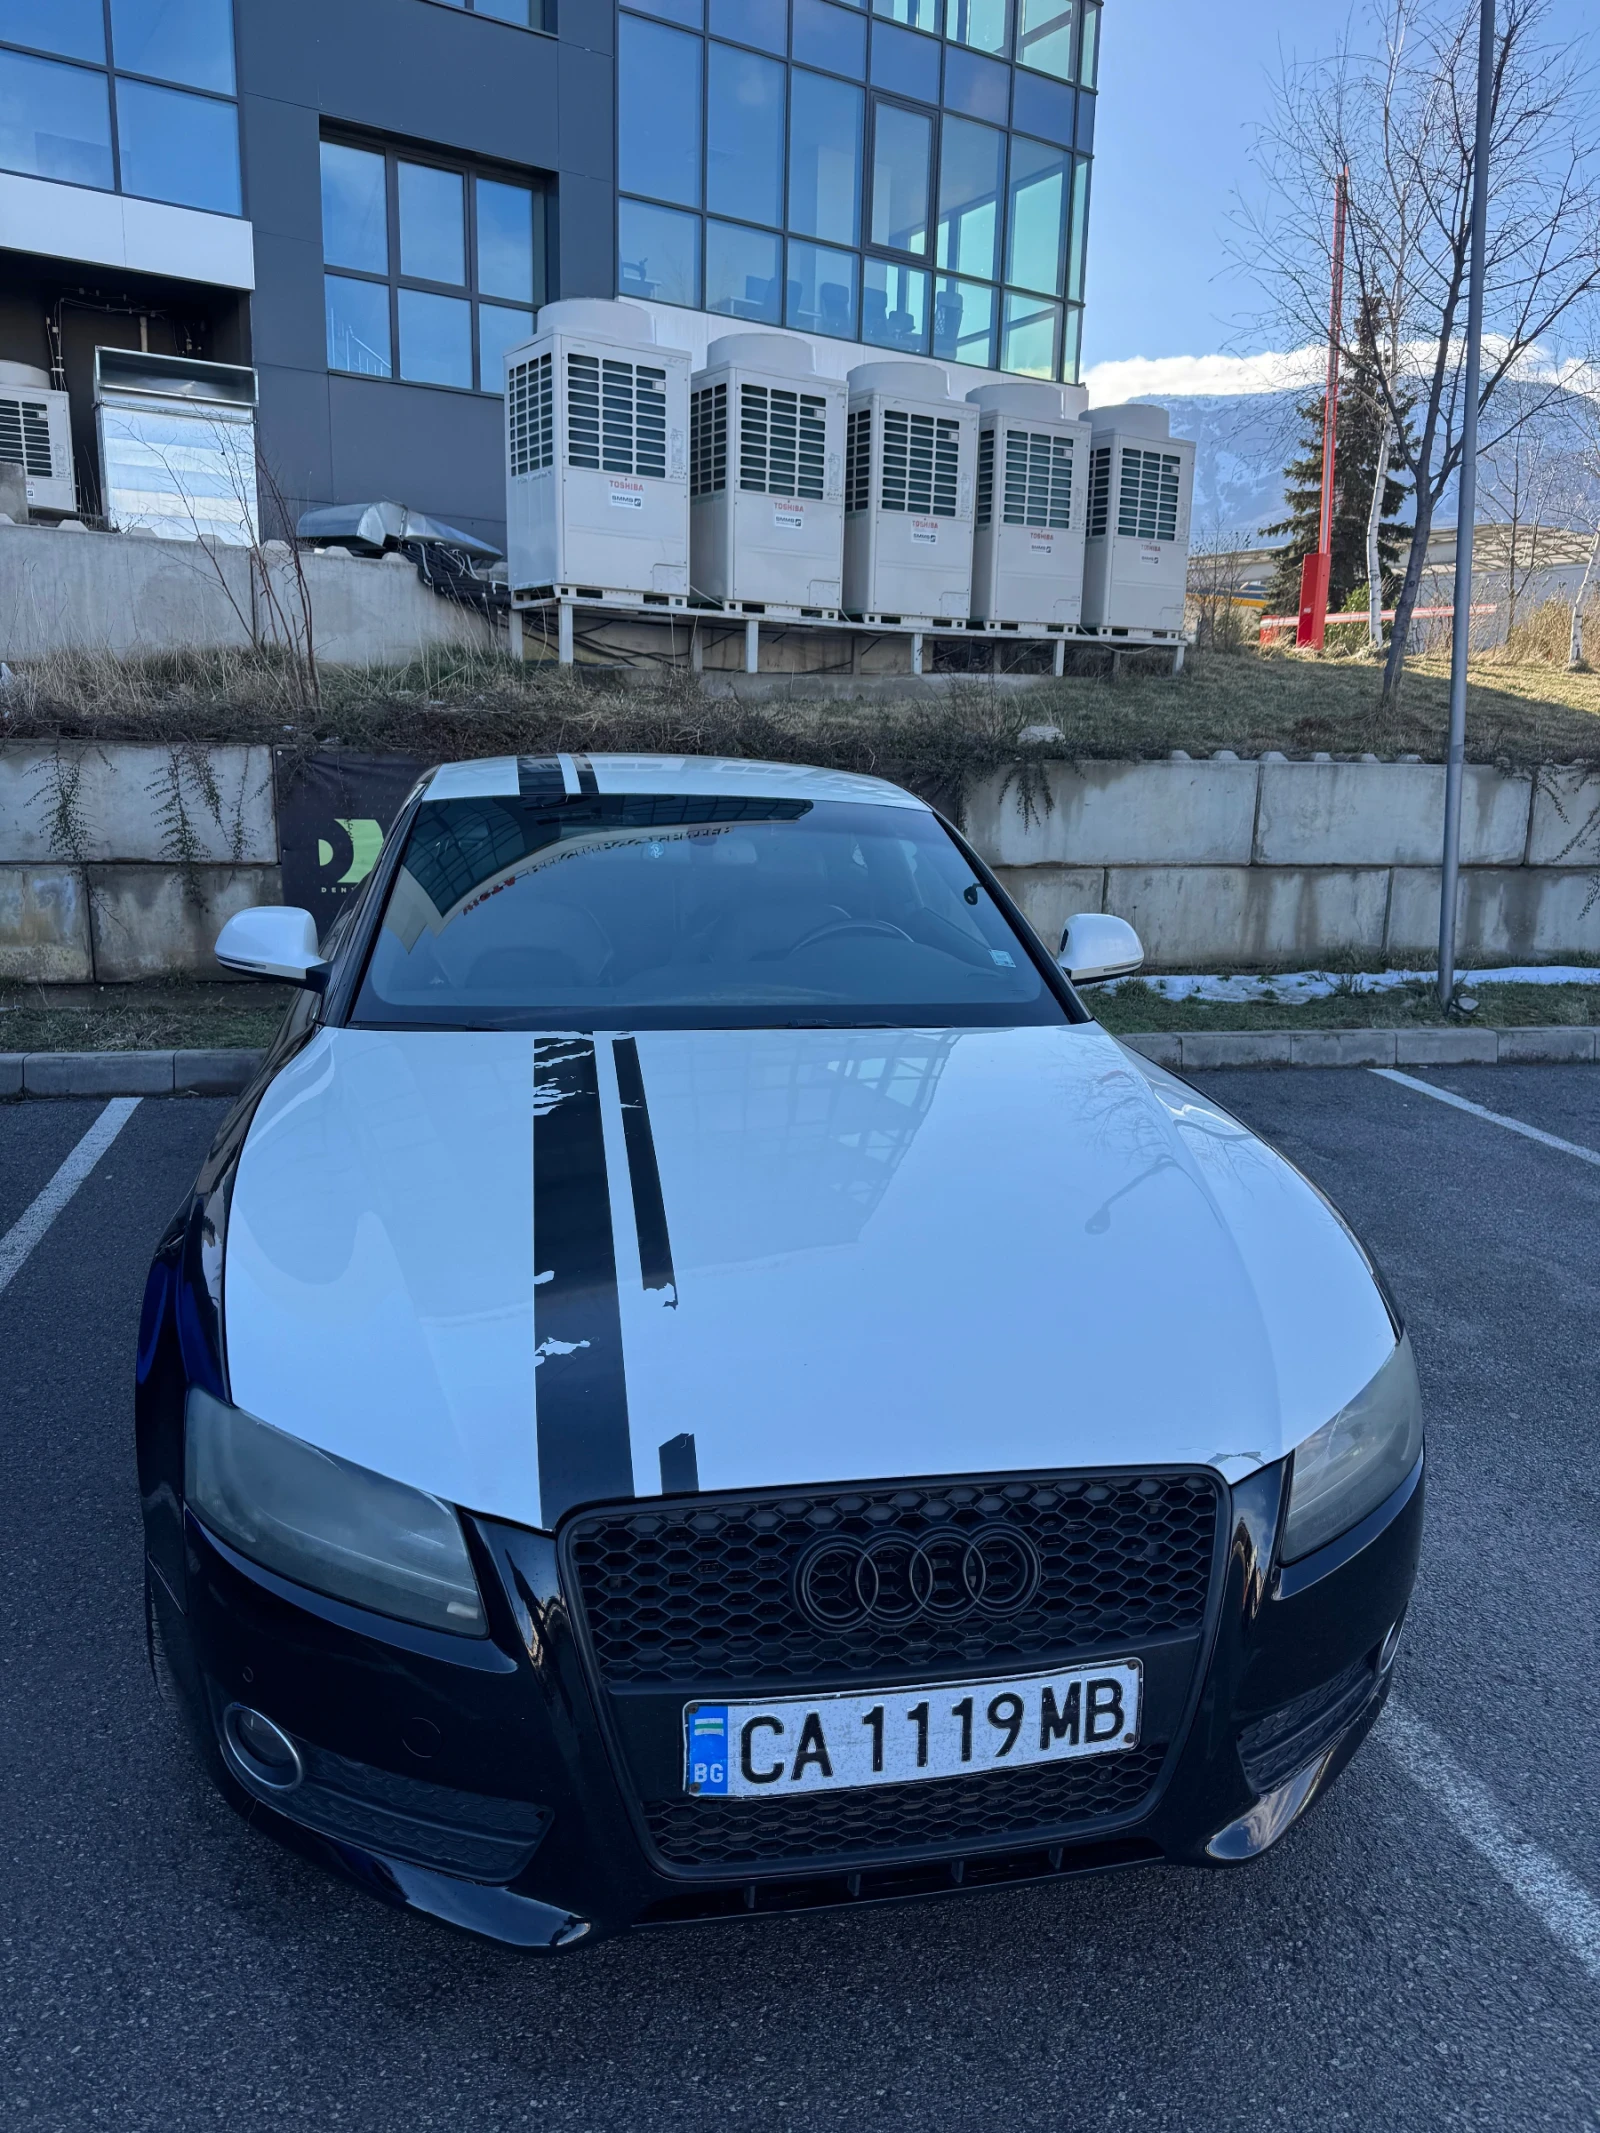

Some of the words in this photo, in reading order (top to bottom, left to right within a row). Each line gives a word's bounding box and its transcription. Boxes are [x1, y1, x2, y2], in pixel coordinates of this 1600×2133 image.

[609, 480, 644, 491] TOSHIBA
[774, 502, 804, 512] TOSHIBA
[912, 520, 938, 529] TOSHIBA
[1030, 532, 1054, 541] TOSHIBA
[321, 886, 354, 894] DEN
[740, 1709, 834, 1784] CA
[861, 1691, 1025, 1772] 1119
[1039, 1676, 1126, 1751] MB
[693, 1762, 724, 1784] BG
